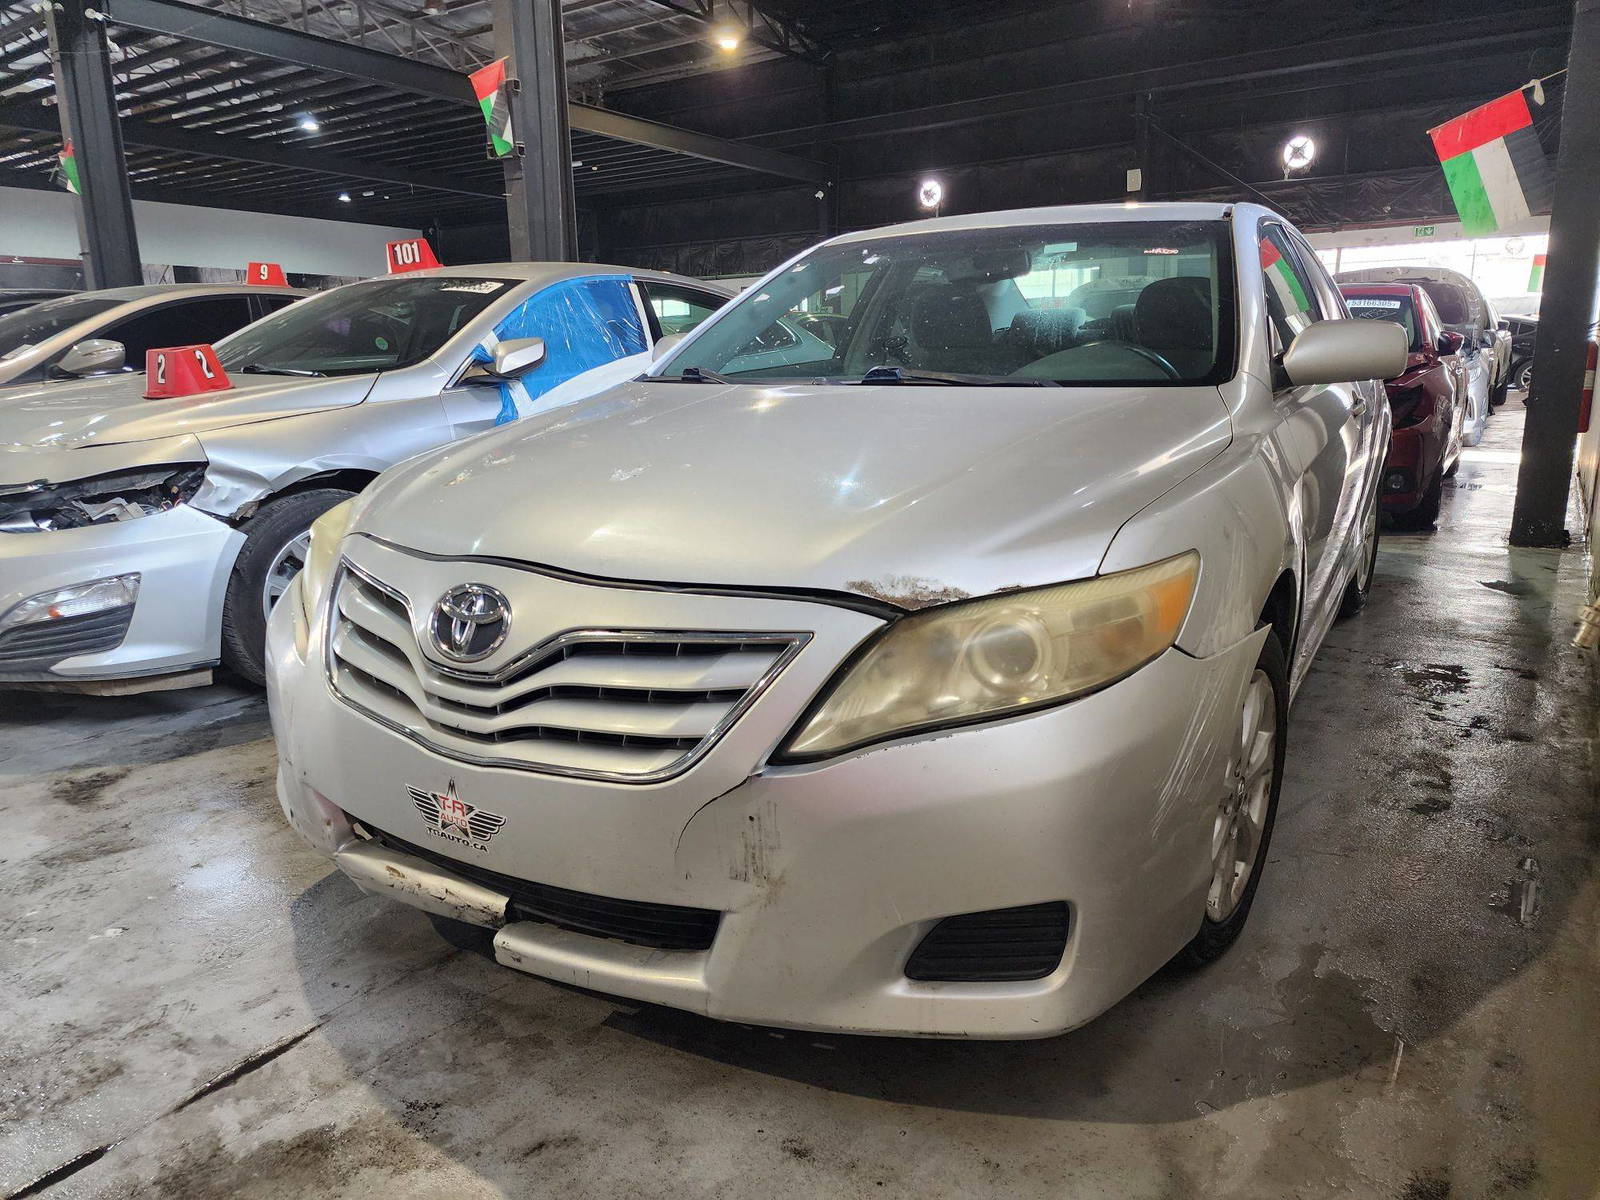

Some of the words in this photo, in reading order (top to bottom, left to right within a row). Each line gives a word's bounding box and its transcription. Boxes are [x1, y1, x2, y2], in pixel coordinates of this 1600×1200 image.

[394, 241, 420, 265] 101
[259, 264, 268, 280] 9
[156, 354, 166, 384] 2
[195, 350, 214, 379] 2
[439, 795, 466, 817] T-R
[440, 813, 467, 828] AUTO
